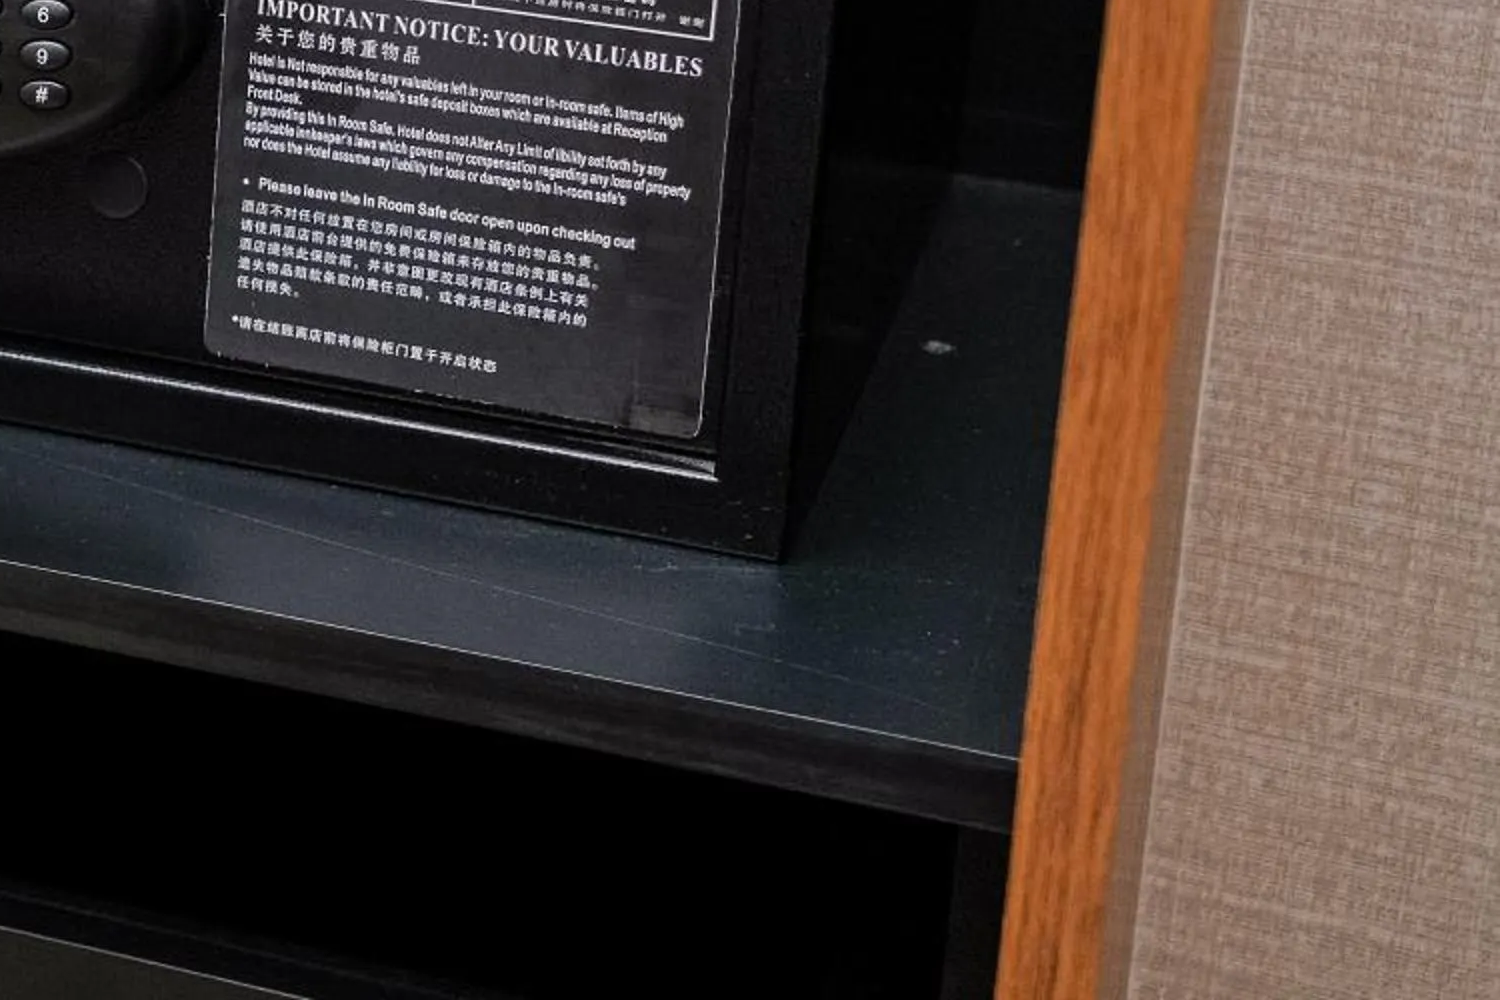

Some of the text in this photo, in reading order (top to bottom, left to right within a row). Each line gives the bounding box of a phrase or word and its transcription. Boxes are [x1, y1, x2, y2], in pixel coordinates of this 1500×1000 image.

[38, 8, 48, 23] 6
[255, 23, 420, 65] 关于您的贵重物品
[393, 15, 490, 47] NOTICE:
[493, 29, 560, 57] YOUR
[563, 39, 703, 77] VALUABLES
[37, 49, 48, 64] 9
[247, 85, 302, 105] Front Desk.
[248, 68, 668, 145] Value can be stored the safe deposit boxes which are available at Reception
[249, 52, 275, 67] Hotel
[287, 57, 305, 72] Not
[306, 60, 363, 83] responsible
[365, 69, 379, 83] for
[380, 74, 398, 89] any
[401, 74, 449, 93] valuables
[451, 81, 466, 95] left
[479, 88, 503, 104] your
[505, 92, 531, 105] room
[532, 96, 544, 107] or
[588, 101, 613, 117] safe.
[646, 110, 657, 123] of
[658, 112, 685, 130] High
[244, 137, 259, 148] nor
[262, 137, 285, 152] does
[287, 141, 302, 155] the
[304, 144, 330, 159] Hotel
[332, 151, 370, 165] assume
[372, 157, 390, 171] any
[430, 163, 443, 177] for
[445, 166, 465, 180] loss
[468, 172, 477, 182] or
[479, 171, 520, 192] damage
[522, 177, 532, 191] to
[534, 179, 550, 194] the
[245, 118, 691, 201] applicable laws which govern any compensation regarding any loss of property
[246, 101, 667, 180] By providing this Room Hotel does not Any Limit of set forth by any
[258, 177, 300, 195] Please
[303, 184, 337, 201] leave
[340, 190, 360, 205] the
[377, 196, 415, 214] Room
[417, 203, 446, 219] Safe
[450, 208, 479, 224] door
[481, 216, 514, 233] open
[516, 222, 549, 239] upon
[551, 225, 612, 249] checking
[613, 235, 636, 250] out
